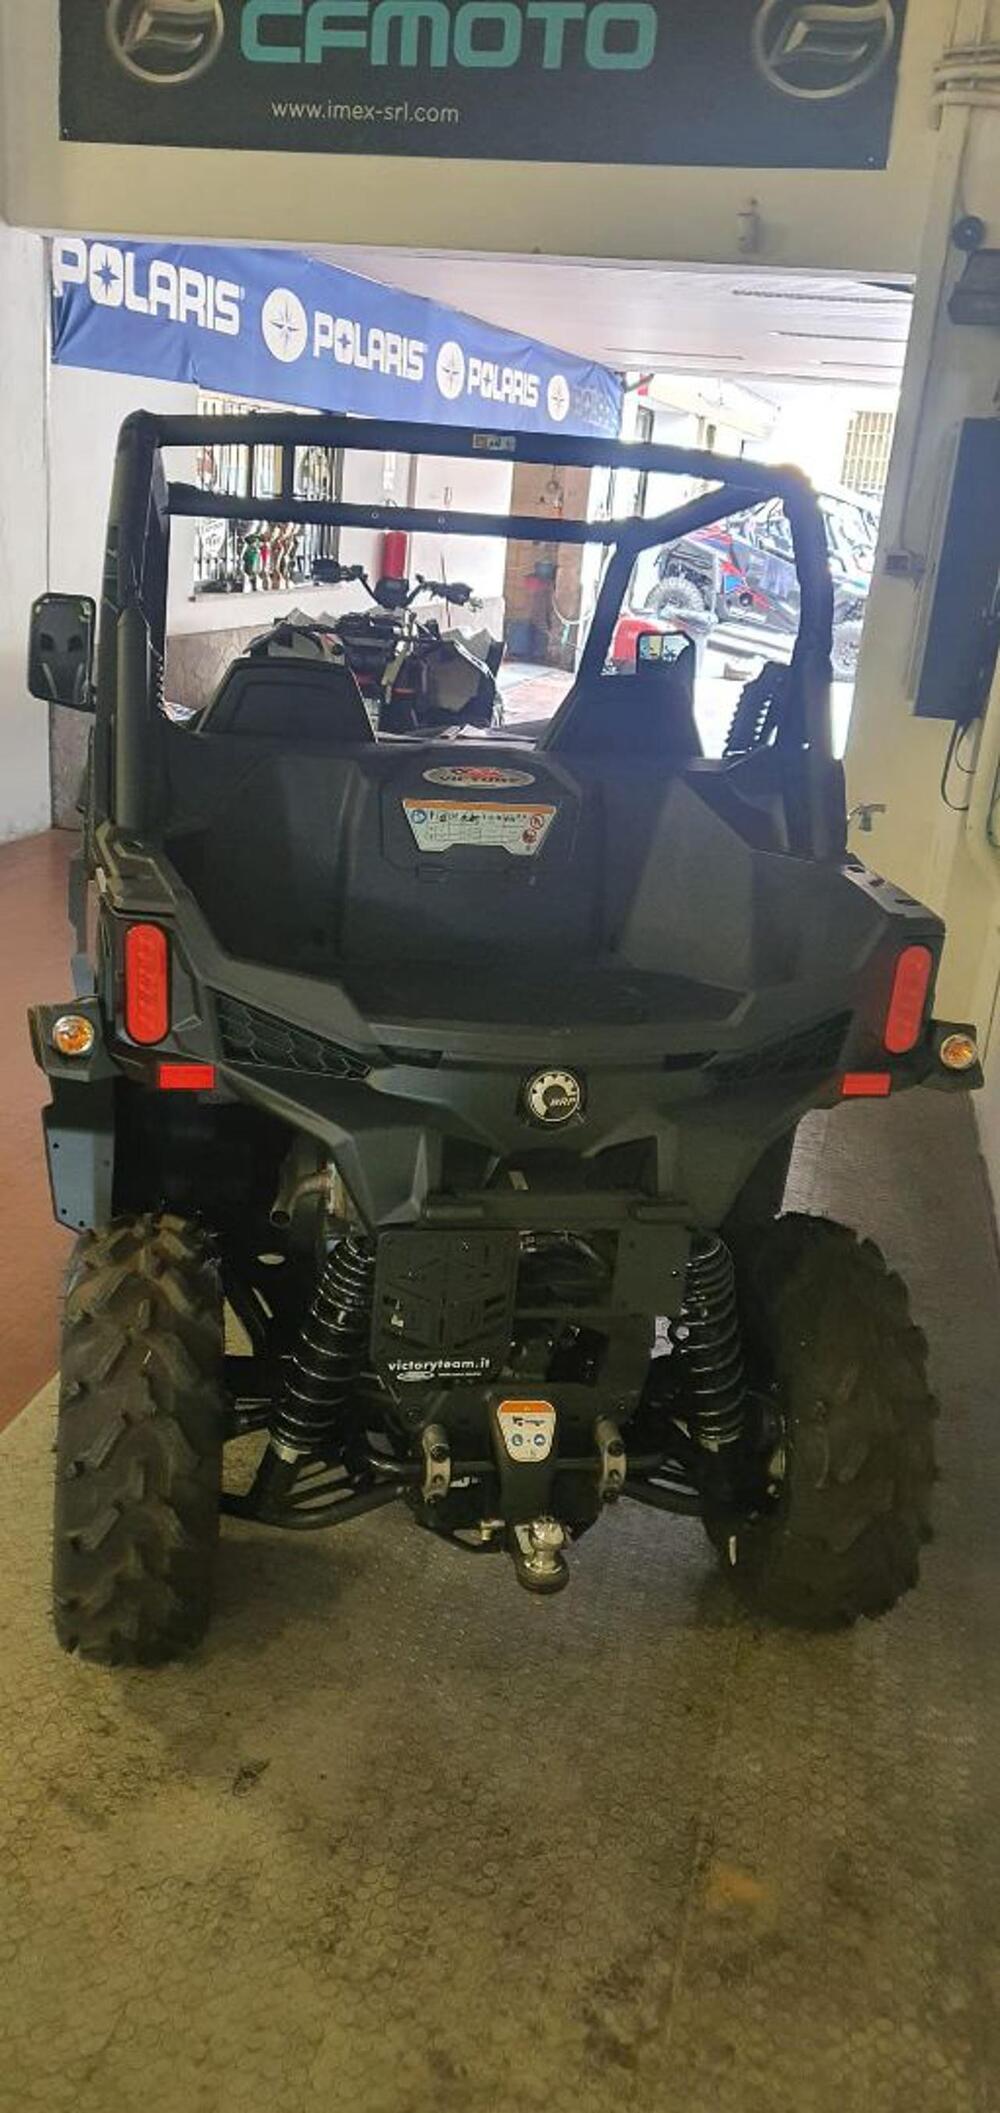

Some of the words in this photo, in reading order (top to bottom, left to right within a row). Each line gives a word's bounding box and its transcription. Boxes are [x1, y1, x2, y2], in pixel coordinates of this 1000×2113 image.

[240, 0, 658, 70] CFMOTO
[271, 100, 460, 124] www.imex-srl.com
[52, 238, 241, 336] POLARIS
[313, 310, 425, 381] POLARIS
[467, 357, 540, 408] POLARIS
[388, 1357, 490, 1372] victoryteam.it
